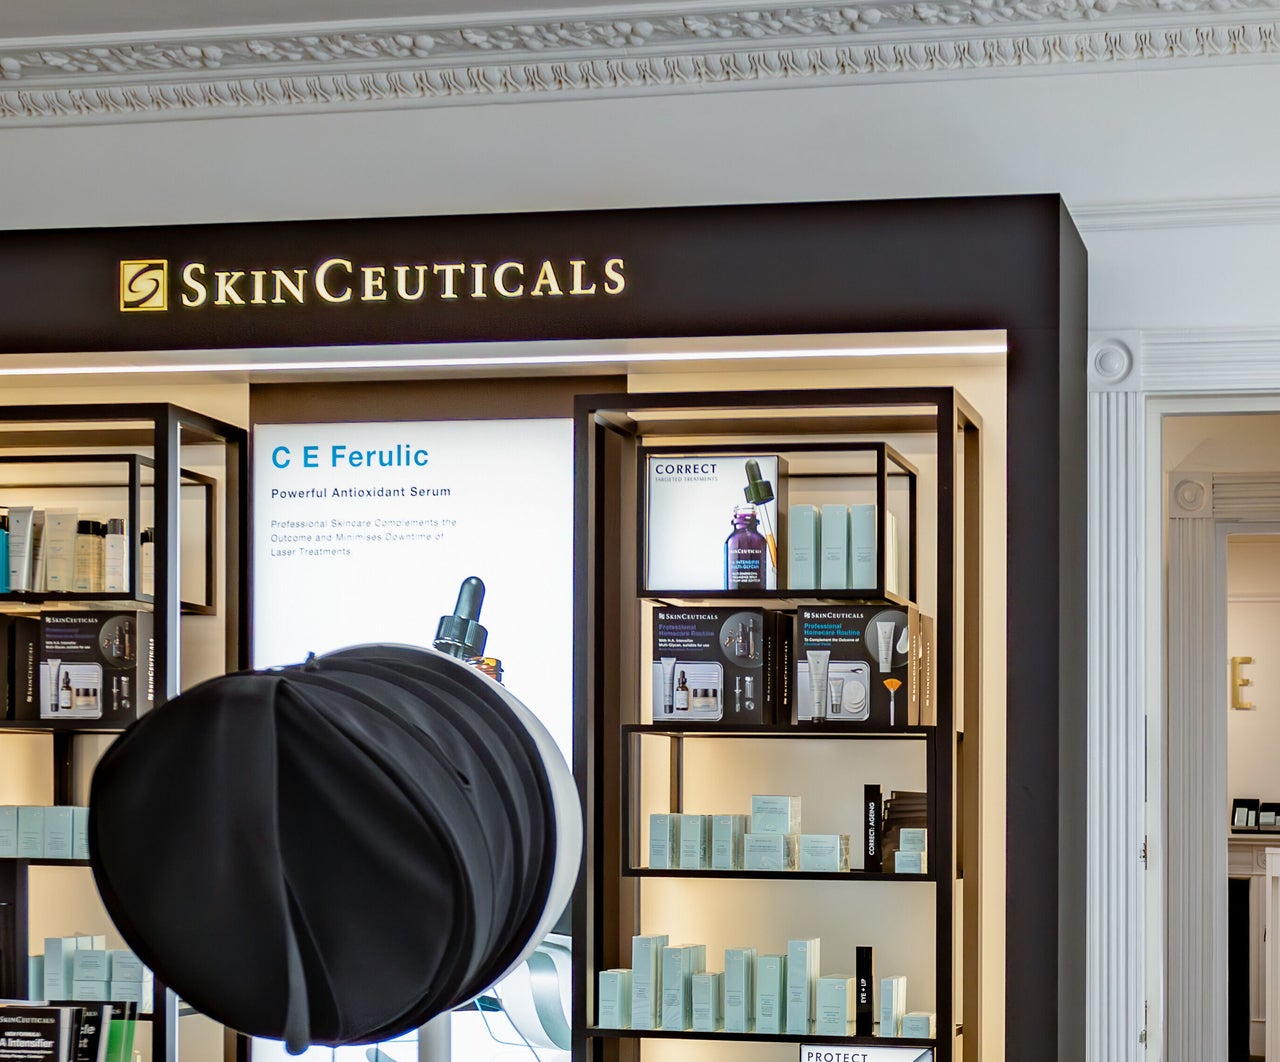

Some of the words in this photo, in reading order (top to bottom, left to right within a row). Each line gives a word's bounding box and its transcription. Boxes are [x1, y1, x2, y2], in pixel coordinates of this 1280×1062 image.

[182, 257, 625, 308] SKINCEUTICALS
[272, 446, 290, 468] C
[303, 446, 319, 468] E
[332, 444, 429, 468] Ferulic
[656, 464, 717, 474] CORRECT
[271, 488, 328, 499] Powerful
[332, 487, 406, 498] Antioxidant
[410, 486, 451, 498] Serum
[271, 520, 328, 528] Professional
[331, 519, 371, 528] Skincare
[374, 518, 438, 527] Complements
[442, 518, 457, 526] the
[271, 534, 312, 542] Outcome
[315, 534, 332, 542] and
[336, 534, 382, 542] Minimises
[385, 532, 432, 541] Downtime
[271, 548, 296, 556] Laser
[299, 548, 351, 556] Treatments
[1232, 656, 1252, 710] E
[8, 1038, 54, 1048] Intensifier
